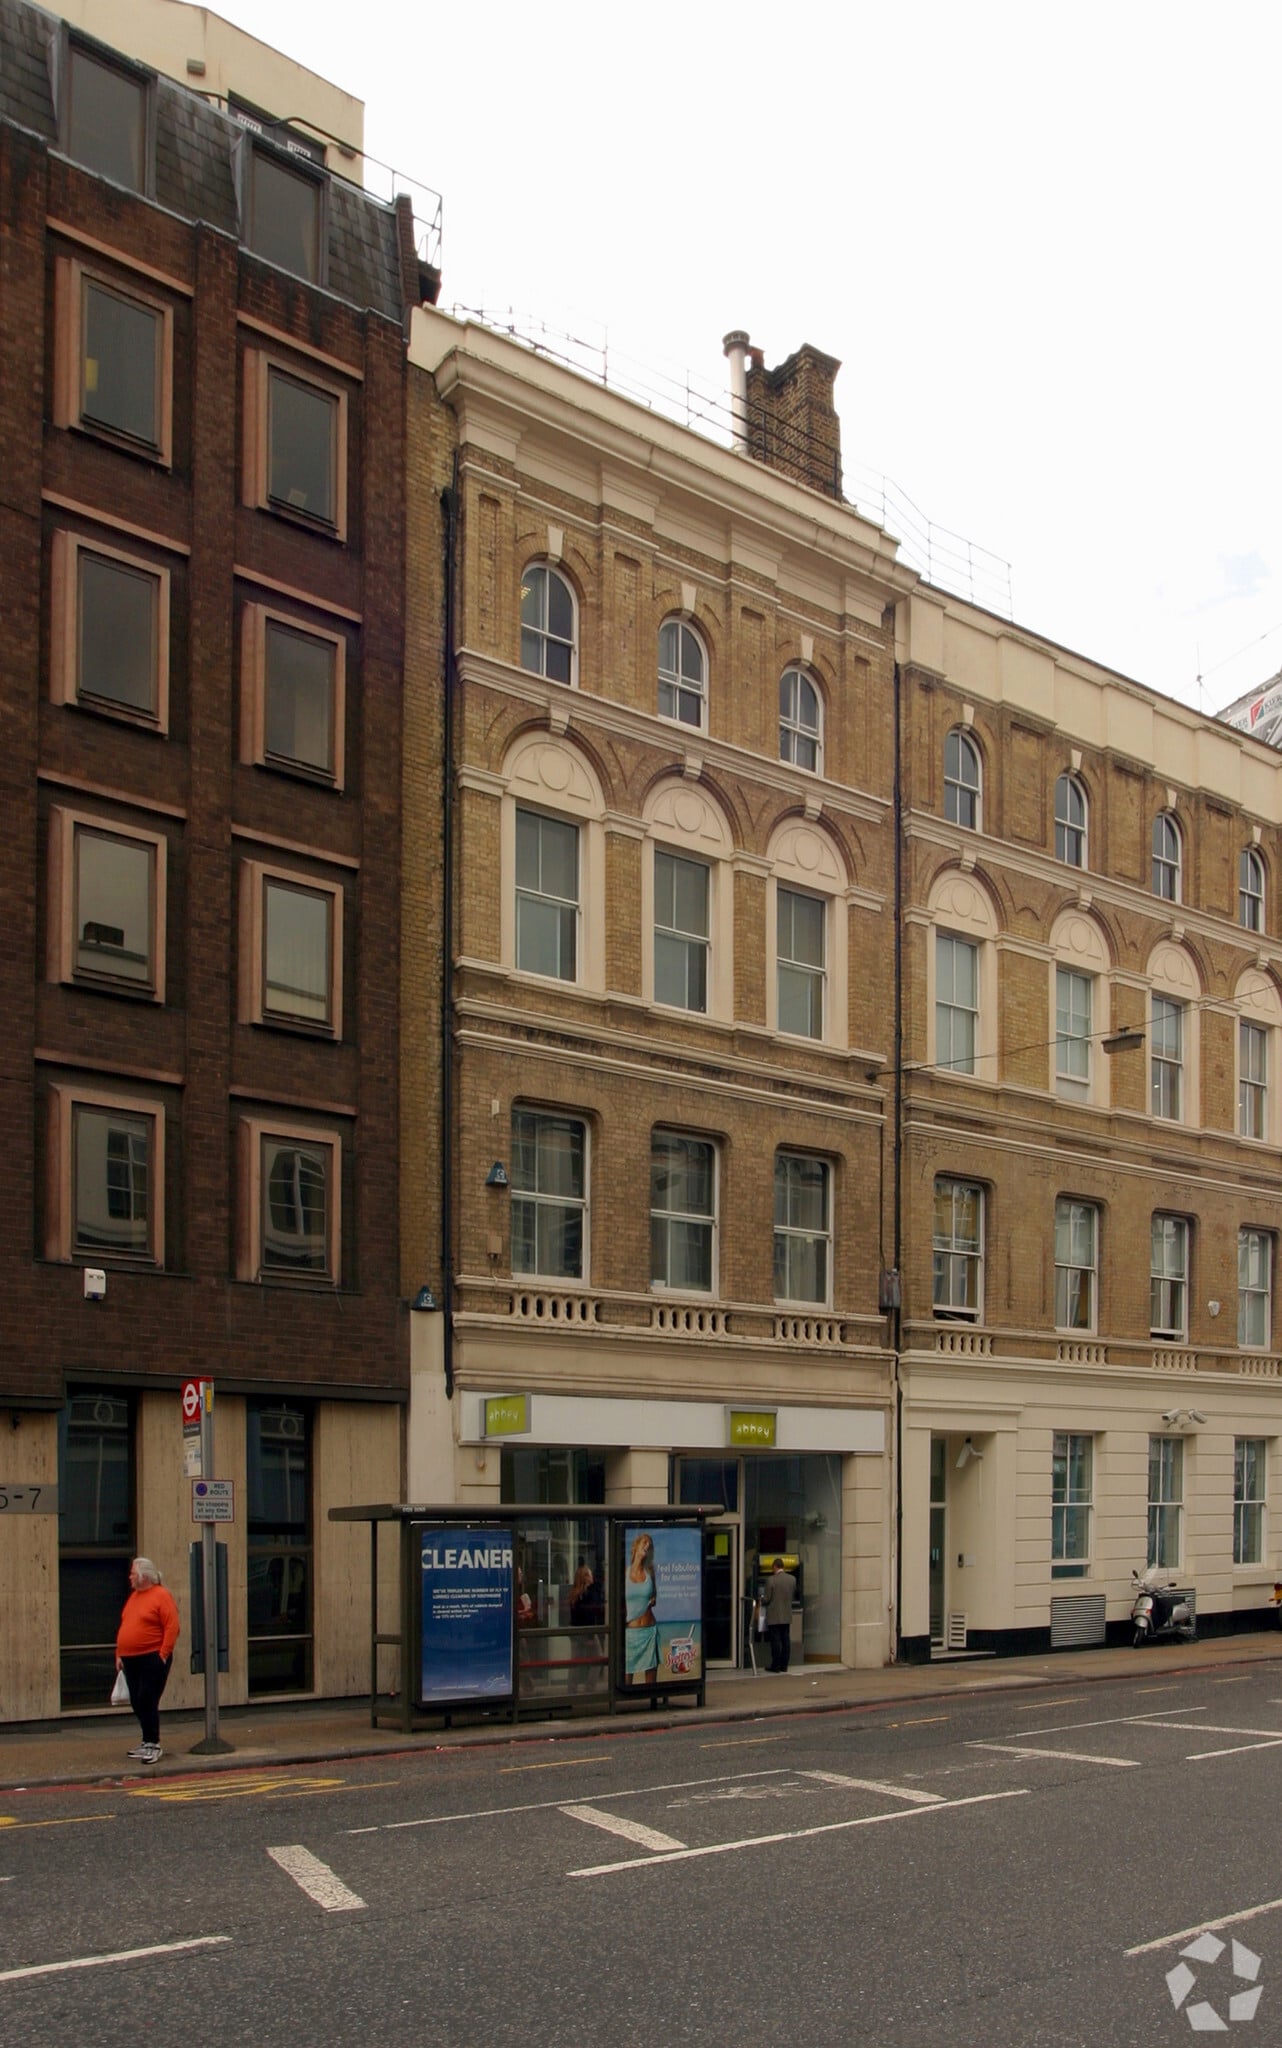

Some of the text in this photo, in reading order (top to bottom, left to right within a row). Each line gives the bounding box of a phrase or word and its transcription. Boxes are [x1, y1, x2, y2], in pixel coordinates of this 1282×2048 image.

[489, 1408, 519, 1422] abbey
[736, 1423, 770, 1439] abbey
[422, 1549, 512, 1569] CLEANER
[656, 1561, 700, 1573] feel fabulous
